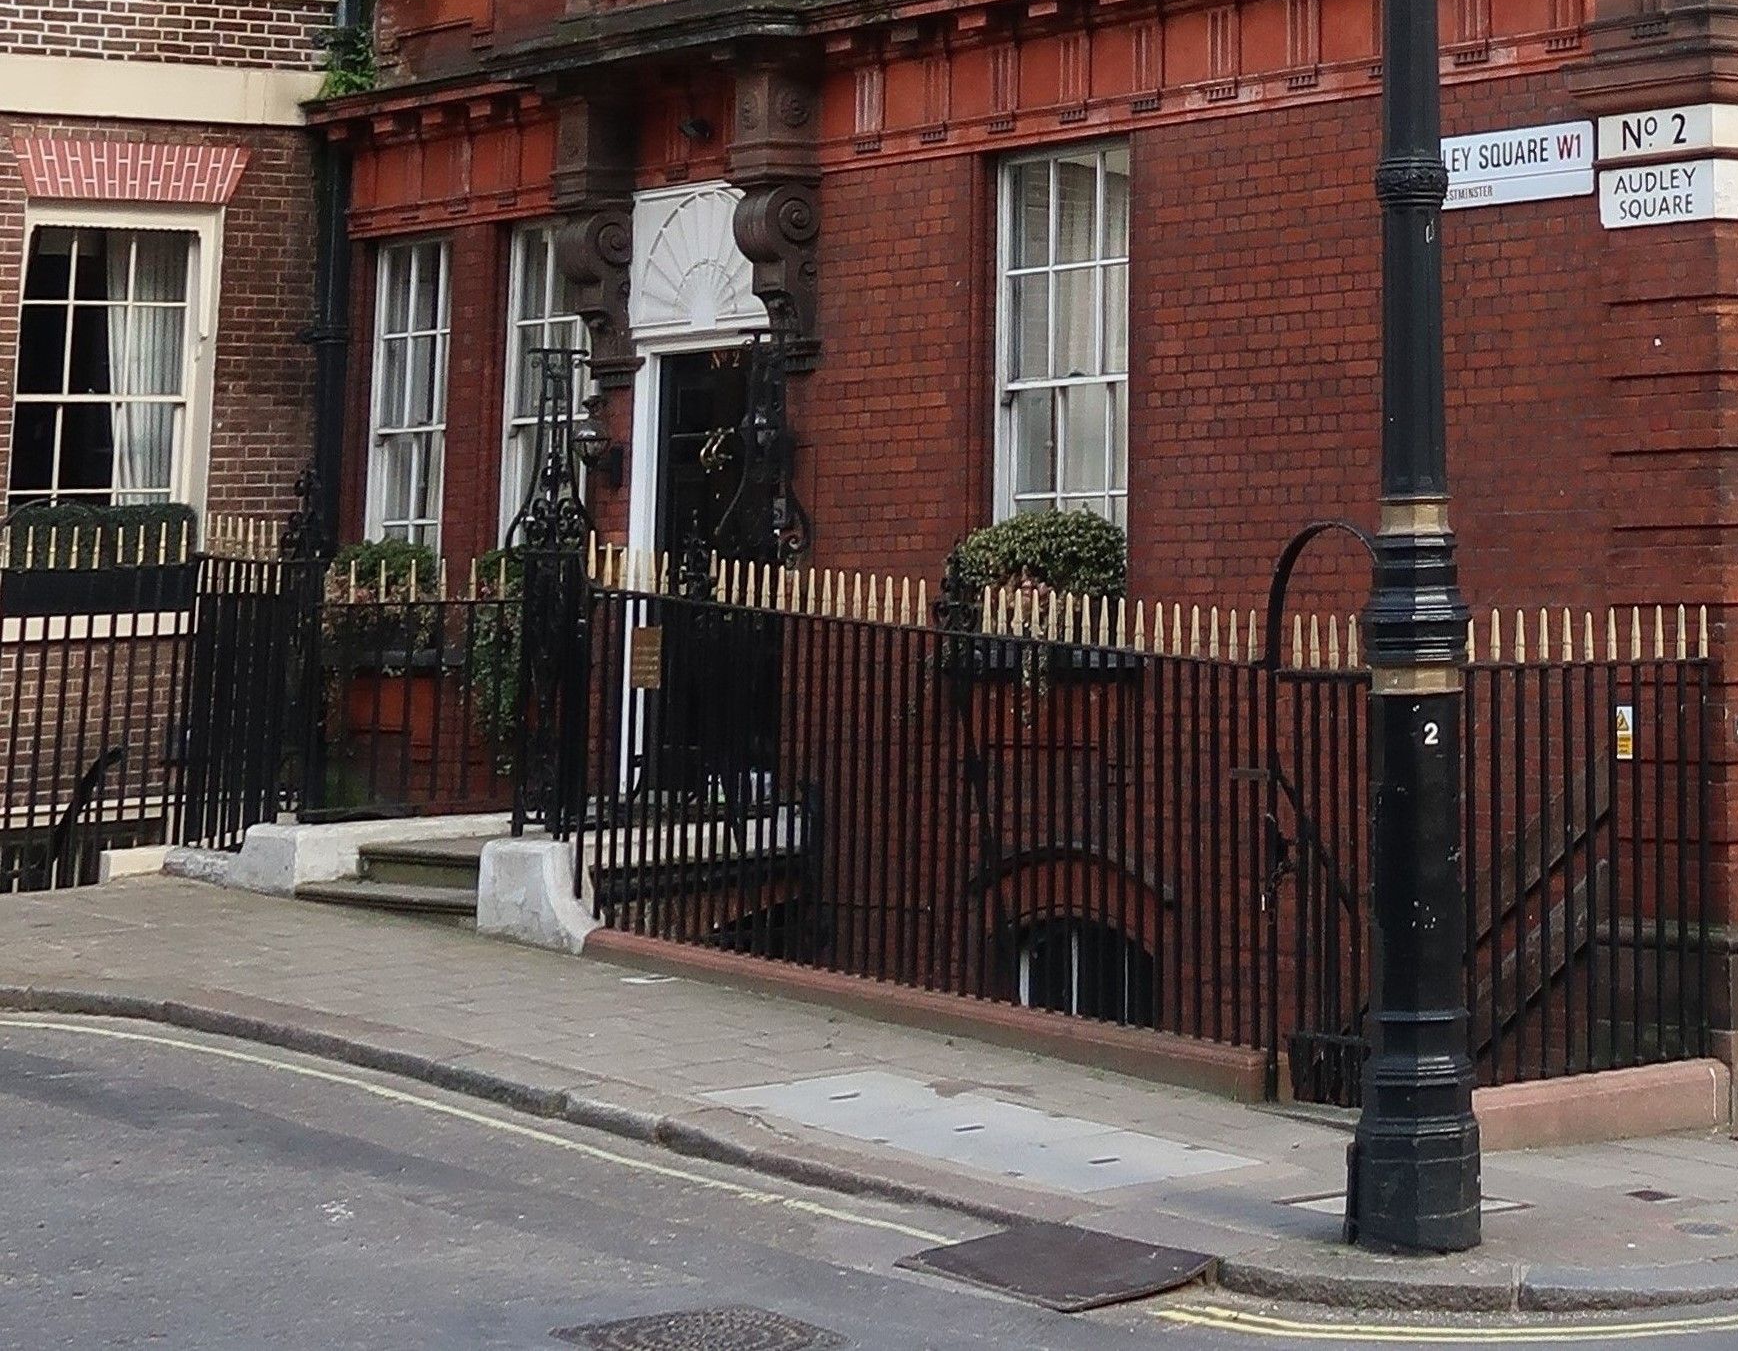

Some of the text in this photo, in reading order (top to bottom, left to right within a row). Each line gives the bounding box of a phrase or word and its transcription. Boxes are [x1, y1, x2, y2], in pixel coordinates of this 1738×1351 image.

[1671, 113, 1687, 145] 2
[1479, 137, 1549, 170] SQUARE
[1556, 133, 1581, 160] W1
[1445, 185, 1493, 201] STMINSTER
[1614, 167, 1697, 195] AUDLEY
[1619, 193, 1693, 220] SQUARE
[1424, 721, 1439, 745] 2
